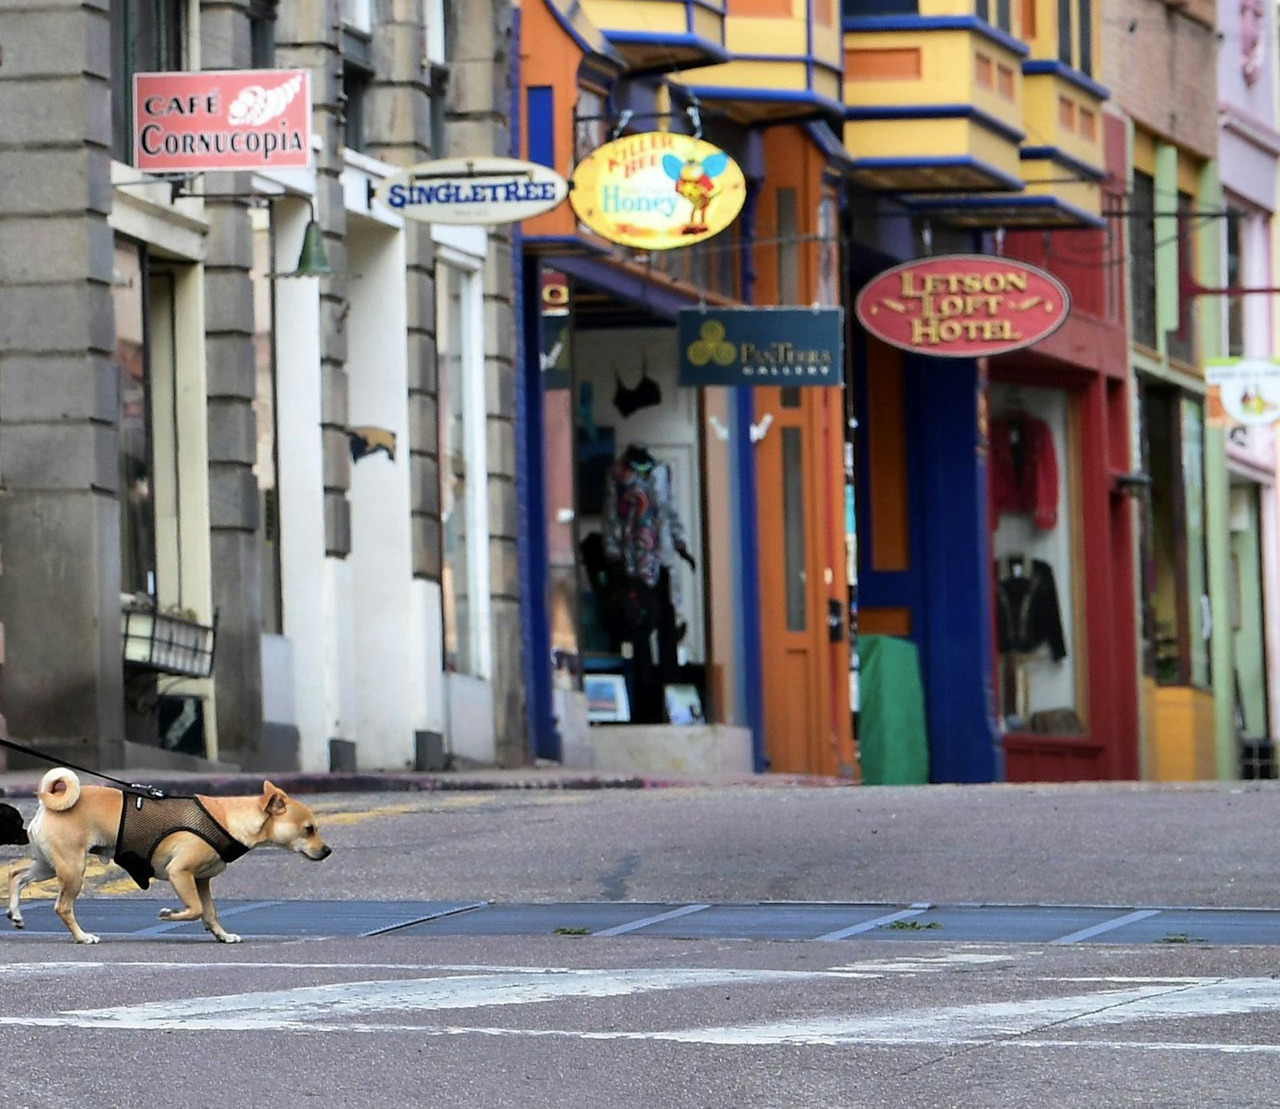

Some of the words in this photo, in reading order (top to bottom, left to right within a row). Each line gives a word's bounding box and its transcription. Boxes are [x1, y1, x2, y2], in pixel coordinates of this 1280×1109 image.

[143, 89, 219, 116] CAFÉ
[389, 181, 556, 208] SINGLETREE
[602, 185, 677, 217] Honey
[900, 271, 1029, 298] LETSON
[921, 294, 1004, 320] LOFT
[911, 318, 1023, 344] HOTEL
[742, 365, 830, 376] GALLERY
